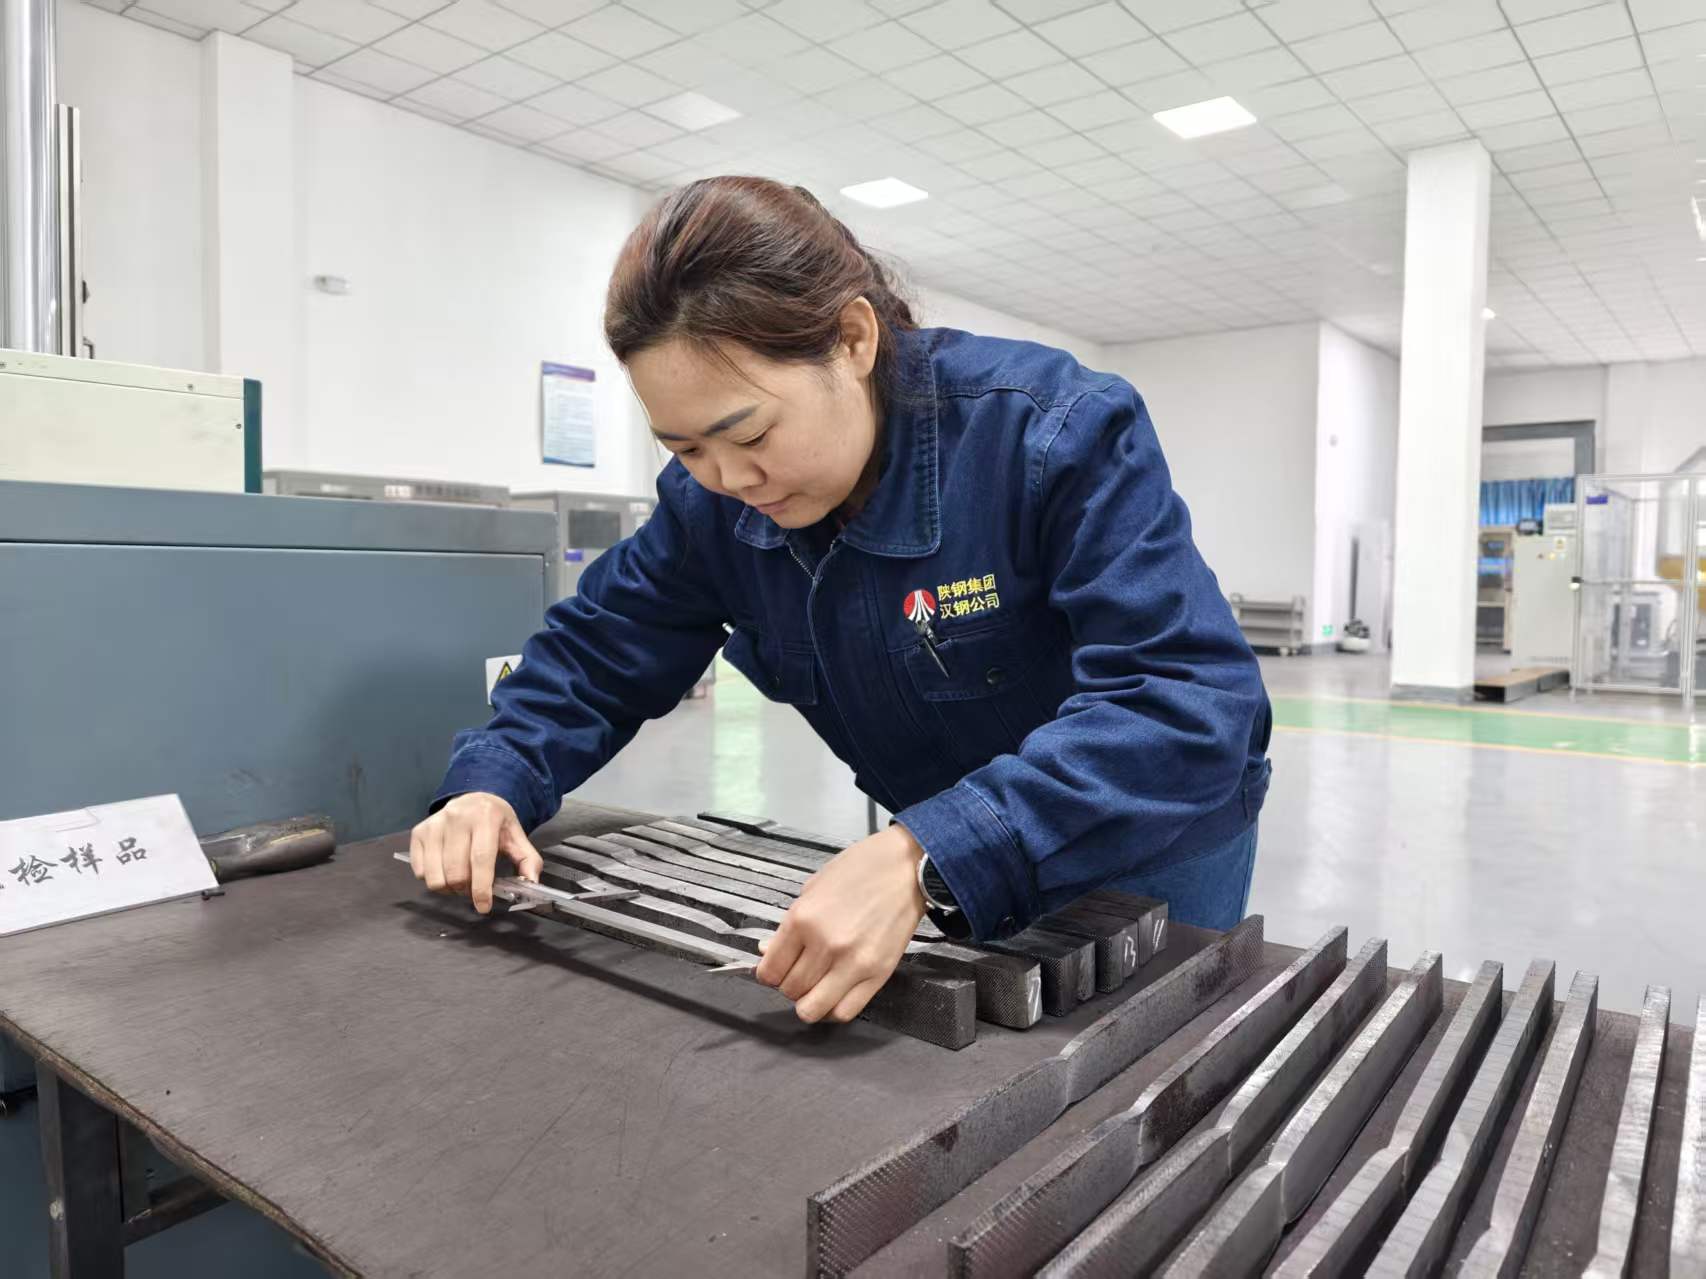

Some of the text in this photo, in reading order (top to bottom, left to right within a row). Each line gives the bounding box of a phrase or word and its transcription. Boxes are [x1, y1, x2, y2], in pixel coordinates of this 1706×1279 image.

[937, 573, 996, 600] 陕钢集团
[940, 593, 1000, 619] 汉钢公司
[0, 836, 147, 890] 检样品
